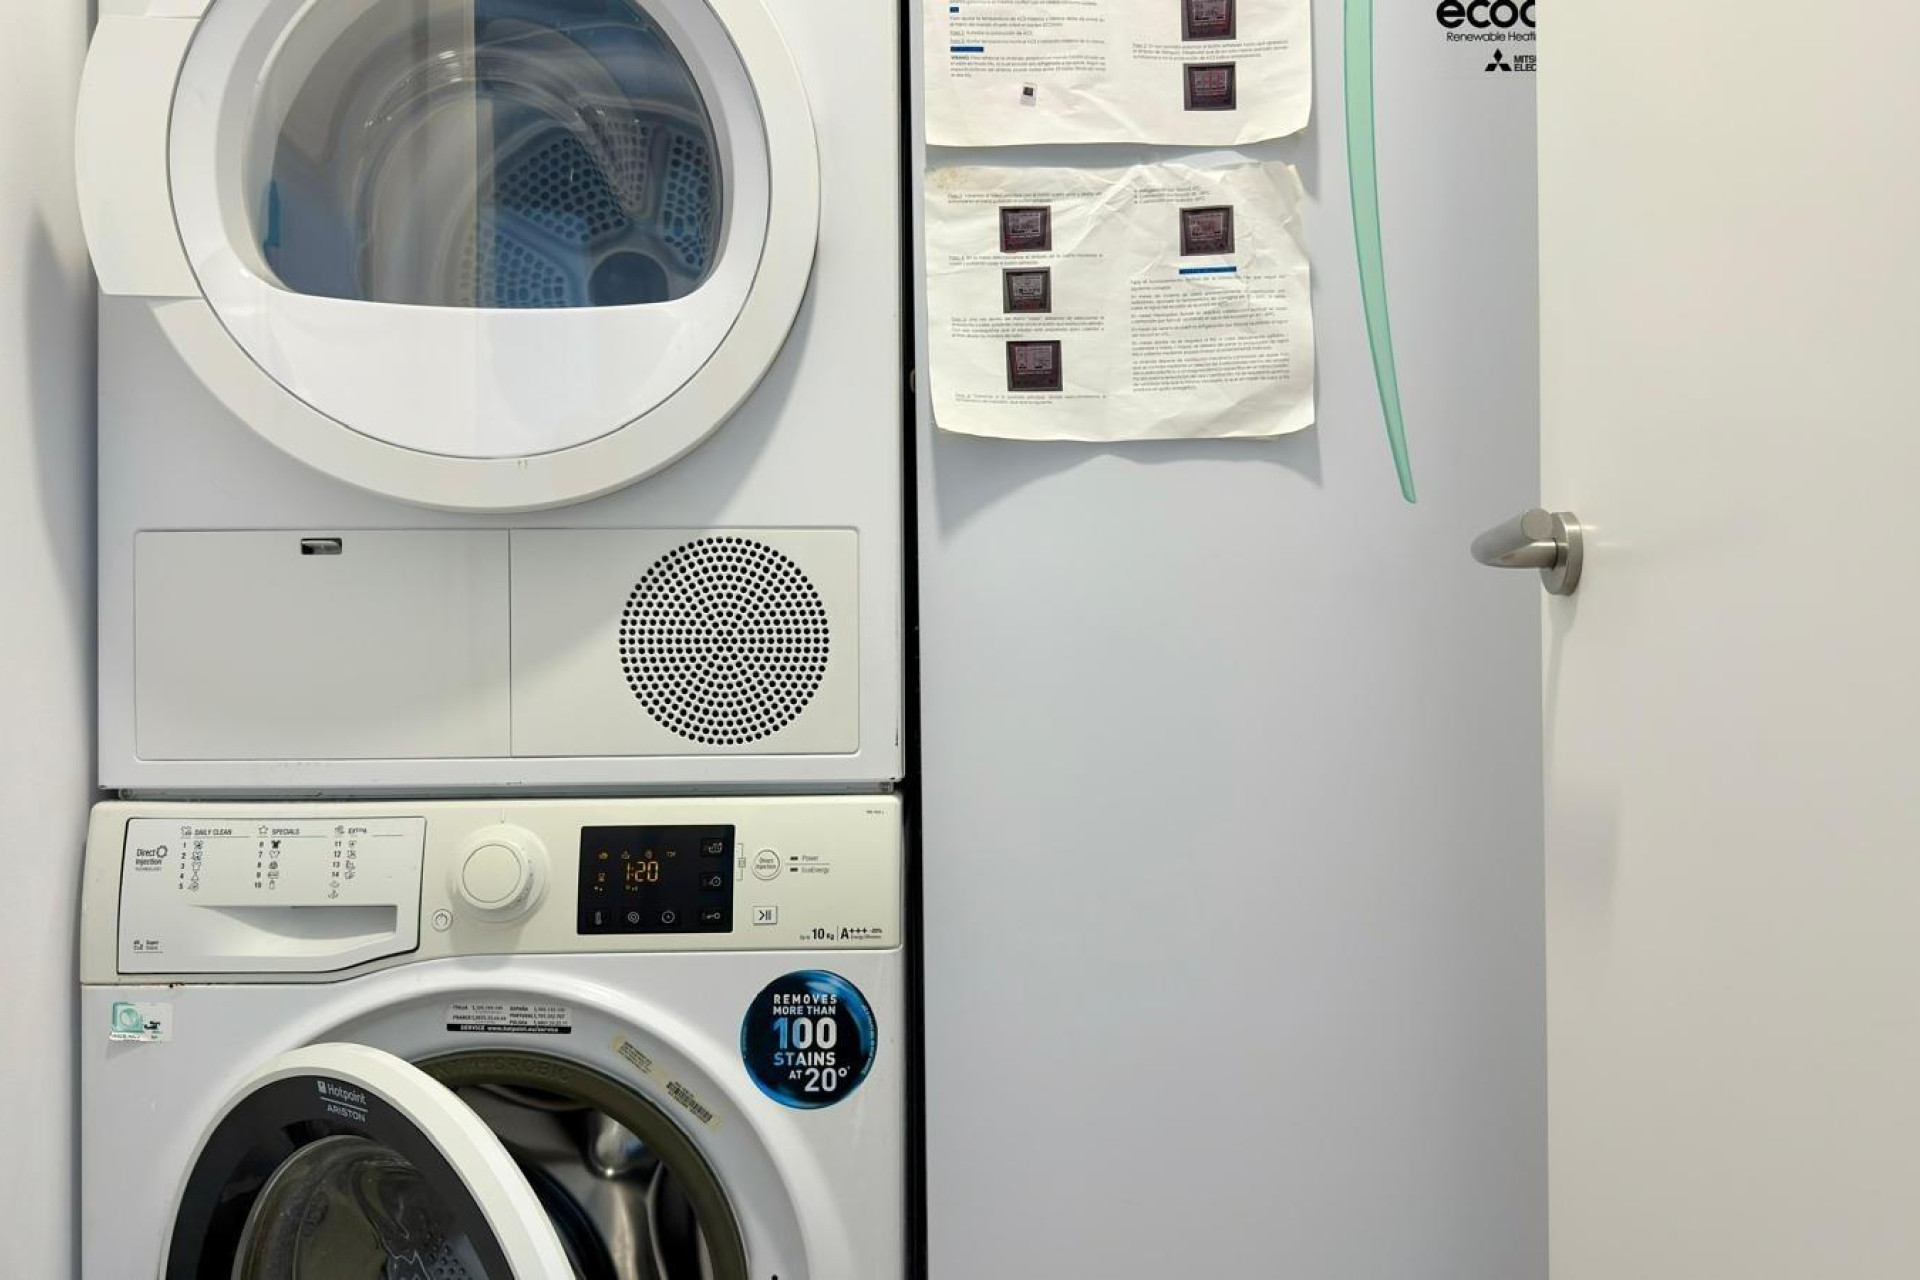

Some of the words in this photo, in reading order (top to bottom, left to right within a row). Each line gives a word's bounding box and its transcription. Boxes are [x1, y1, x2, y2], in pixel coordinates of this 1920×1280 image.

[1446, 32, 1506, 42] Renewable
[136, 848, 156, 857] Direct
[334, 850, 341, 858] 12
[626, 861, 659, 882] 1:20
[812, 928, 825, 940] 10
[840, 926, 868, 940] A+++
[773, 993, 838, 1005] REMOVES
[773, 1005, 804, 1015] MORE
[807, 1005, 836, 1015] THAN
[773, 1017, 837, 1049] 100
[773, 1052, 836, 1066] STAINS
[788, 1070, 803, 1080] AT
[326, 1083, 367, 1106] Hotpoint
[327, 1104, 366, 1123] ARISTON
